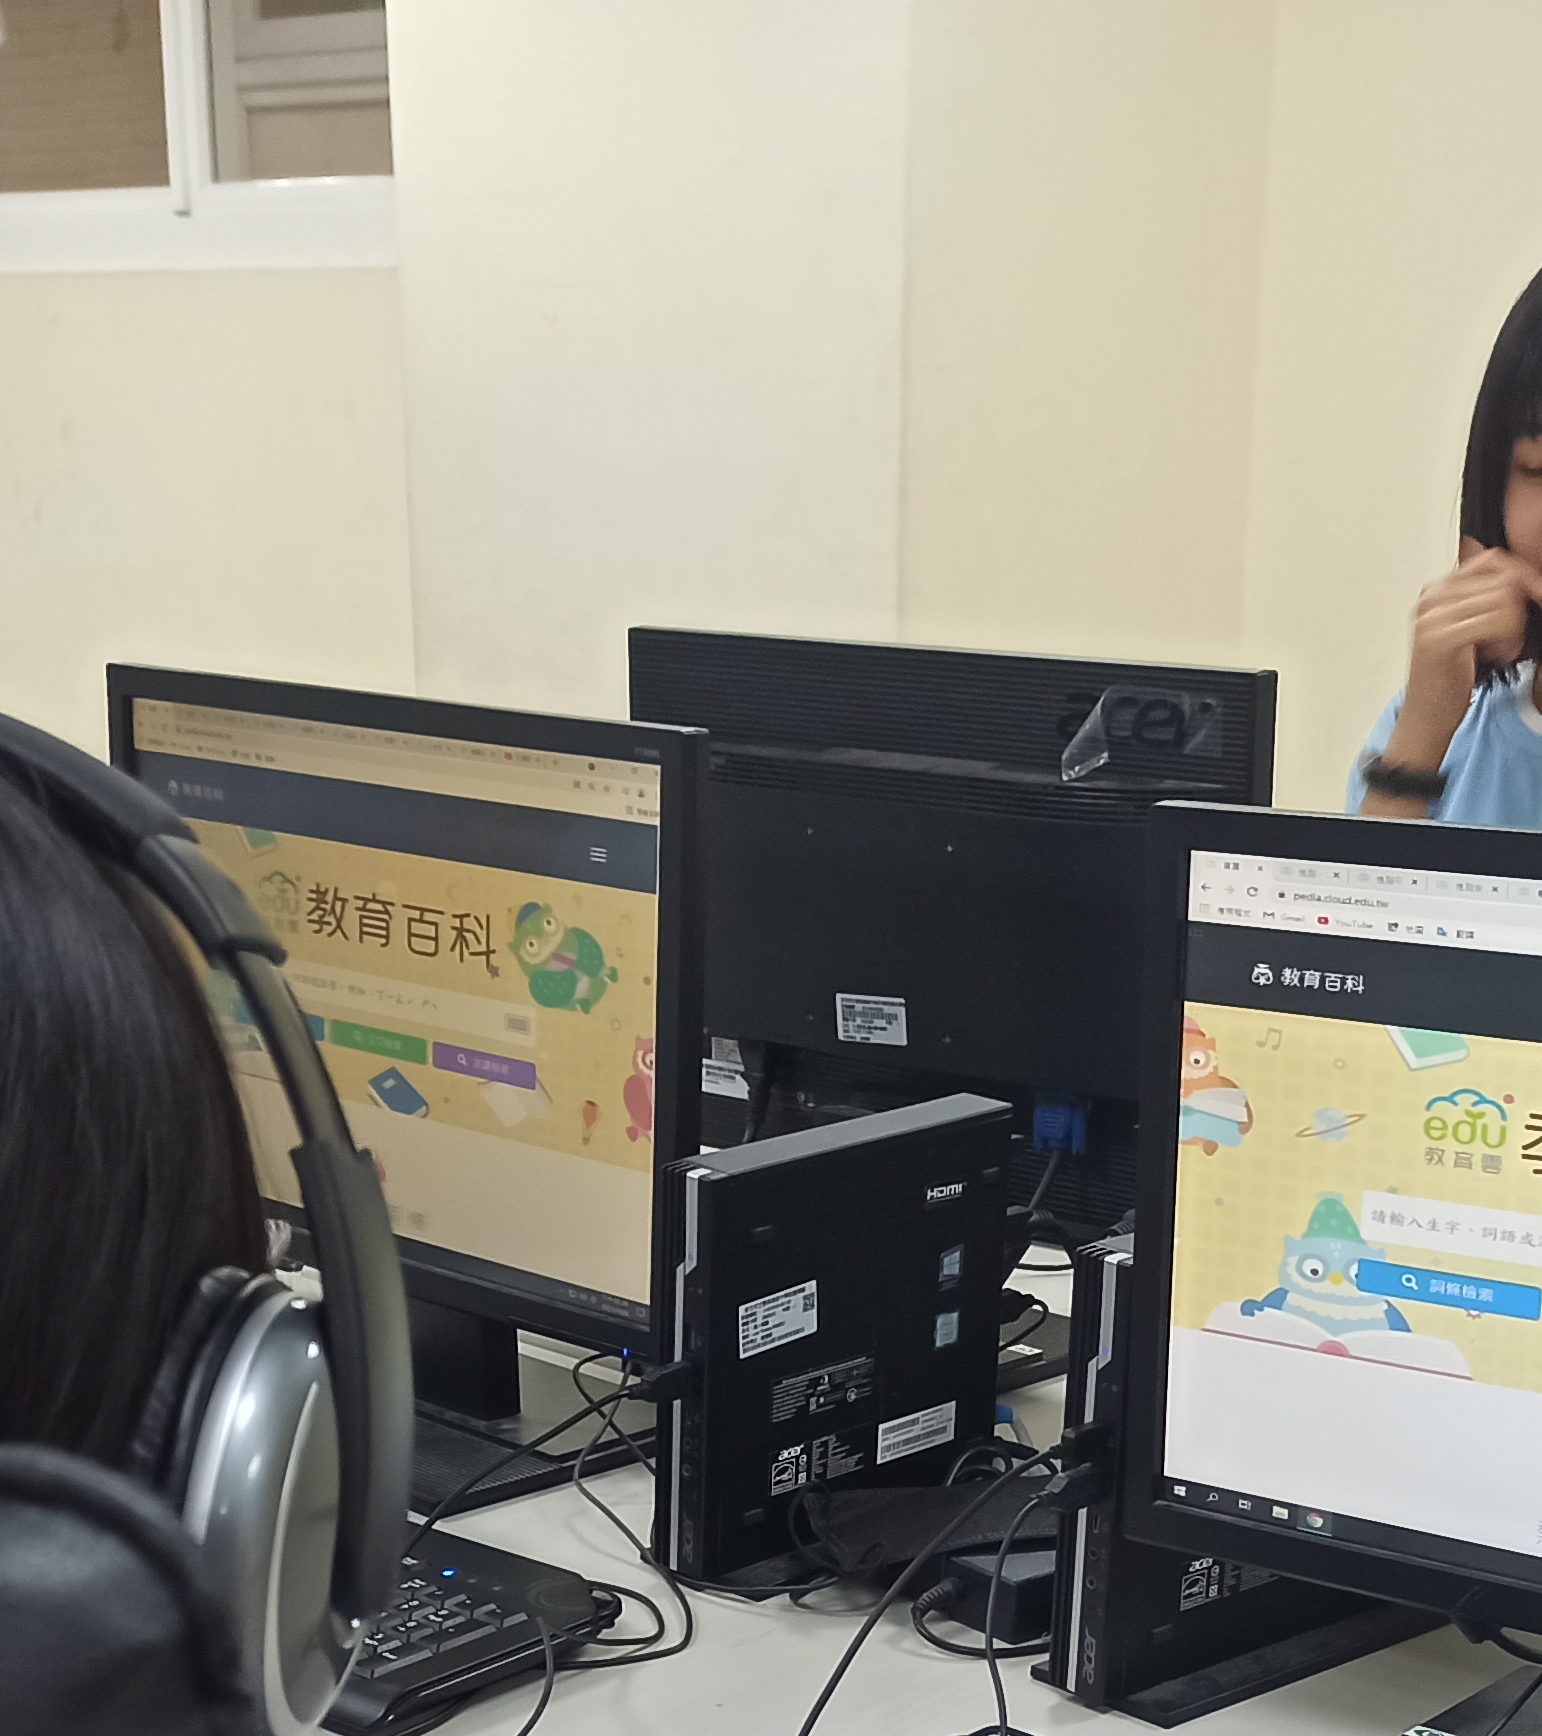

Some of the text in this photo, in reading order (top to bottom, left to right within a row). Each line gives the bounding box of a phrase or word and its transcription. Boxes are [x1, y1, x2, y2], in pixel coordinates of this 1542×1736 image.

[306, 883, 496, 969] 教育百科
[1280, 966, 1365, 994] 教育百科
[1423, 1109, 1507, 1149] edu
[925, 1182, 964, 1202] HDMI
[1082, 1626, 1097, 1685] acer
